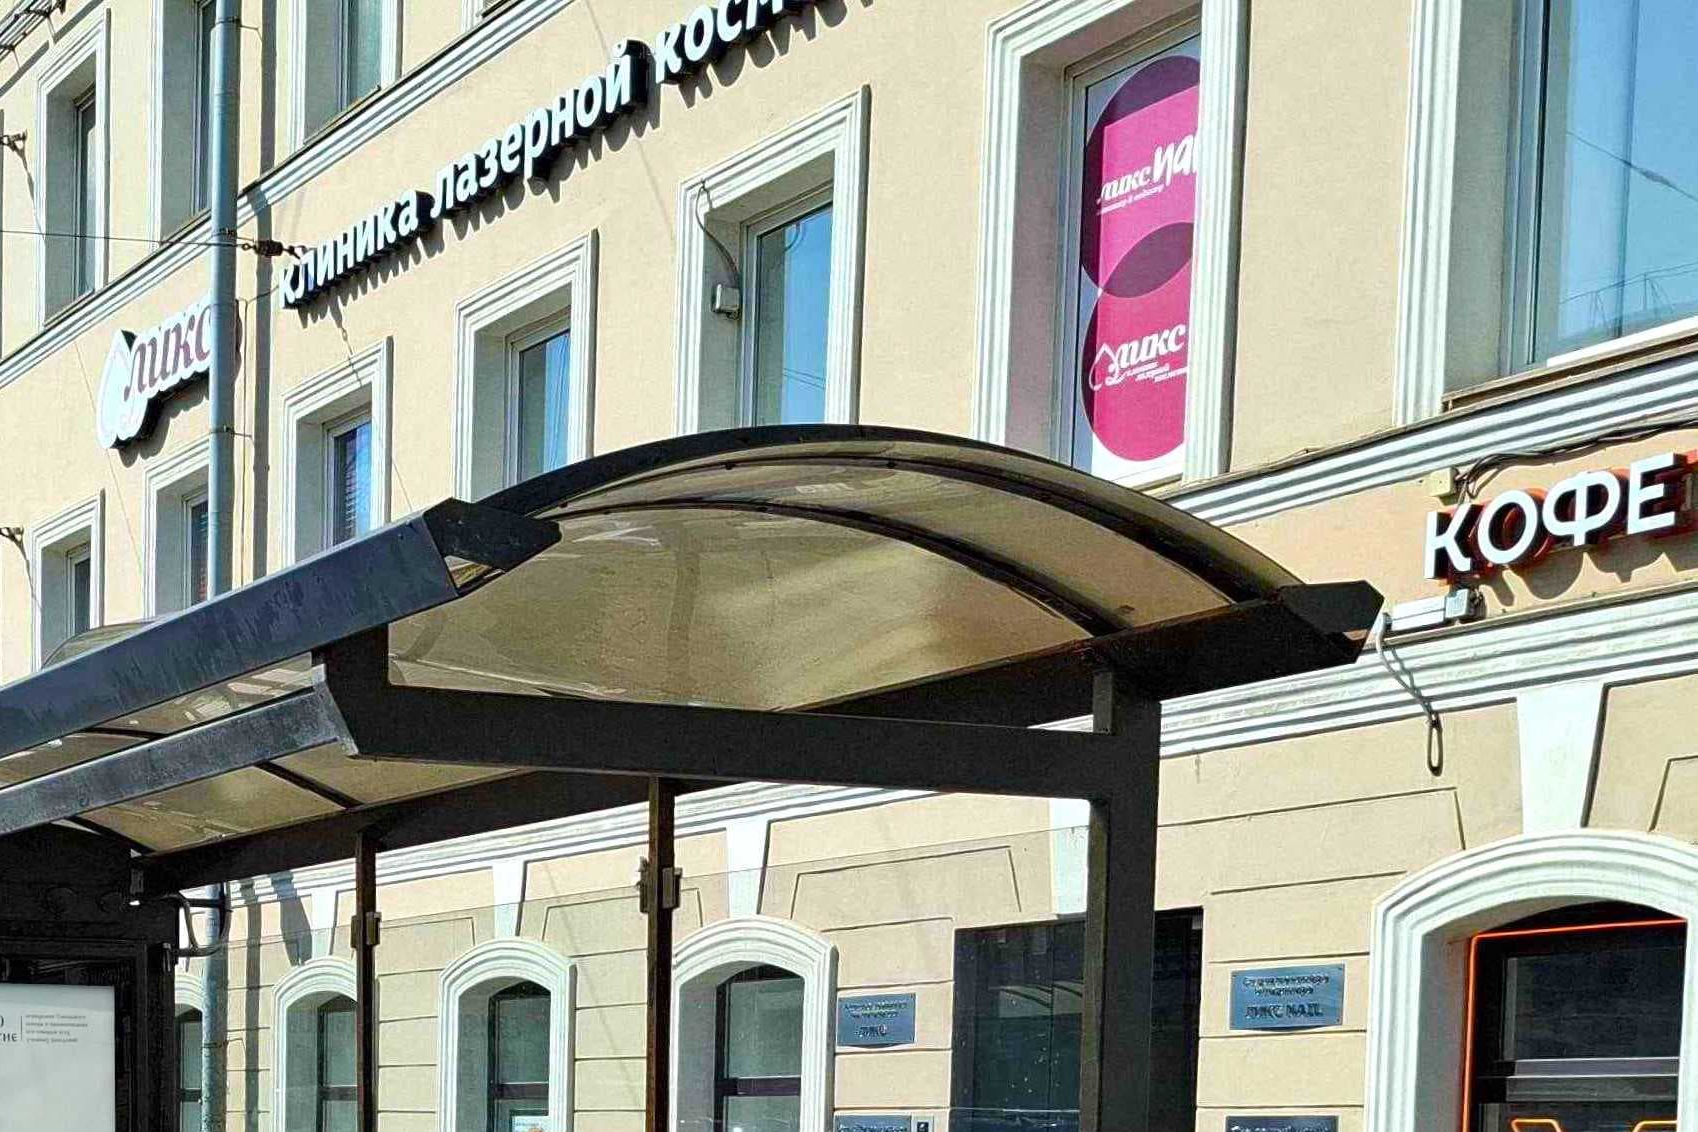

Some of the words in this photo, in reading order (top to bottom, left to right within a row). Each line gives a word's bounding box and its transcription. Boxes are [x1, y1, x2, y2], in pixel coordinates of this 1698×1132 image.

[279, 191, 418, 308] клиника
[431, 39, 631, 218] лазерной
[1424, 453, 1676, 579] КОФЕ
